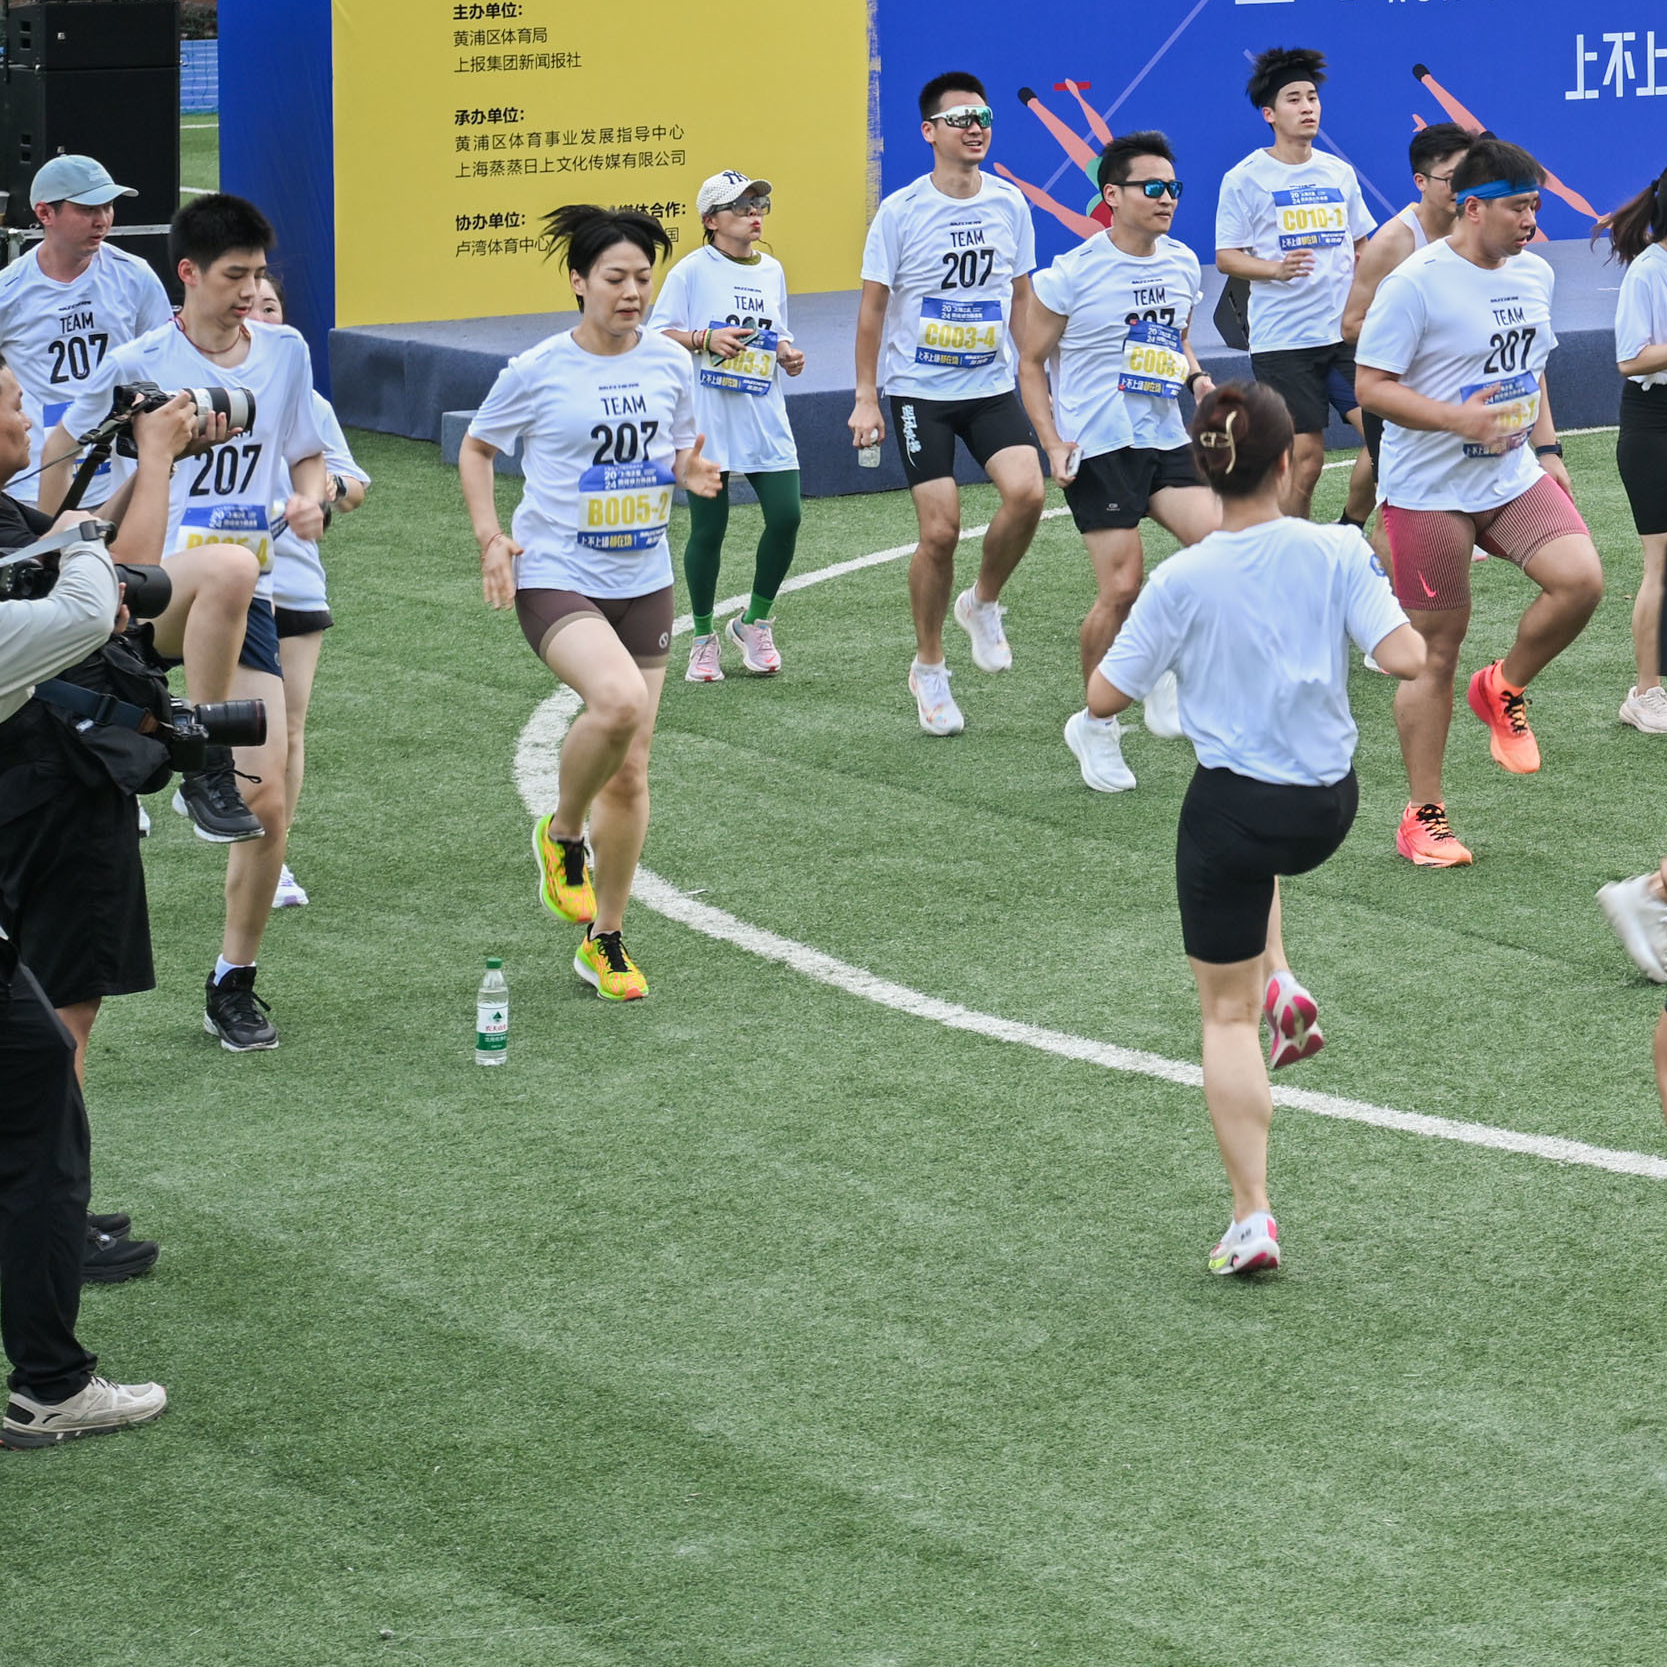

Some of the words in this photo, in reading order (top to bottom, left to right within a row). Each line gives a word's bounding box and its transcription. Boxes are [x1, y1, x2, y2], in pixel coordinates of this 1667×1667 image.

[453, 2, 523, 20] 主办单位：
[453, 27, 548, 47] 黄浦区体育局
[453, 51, 582, 73] 上报集团新闻报社
[454, 107, 525, 126] 承办单位：
[455, 124, 685, 153] 黄浦区体育事业发展指导中心
[455, 149, 686, 179] 上海蒸蒸日上文化传媒有限公司
[455, 212, 526, 231] 协办单位：
[1283, 208, 1344, 231] C010-1
[455, 236, 550, 258] 卢湾体育中心
[951, 230, 985, 248] TEAM
[941, 249, 994, 290] 207
[734, 295, 765, 313] TEAM
[1133, 287, 1167, 307] TEAM
[59, 312, 94, 334] TEAM
[1492, 307, 1526, 327] TEAM
[925, 322, 996, 350] C003-4
[48, 333, 109, 385] 207
[1483, 328, 1537, 374] 207
[601, 394, 647, 416] TEAM
[591, 421, 659, 465] 207
[189, 444, 263, 497] 207
[588, 492, 669, 527] B005-2
